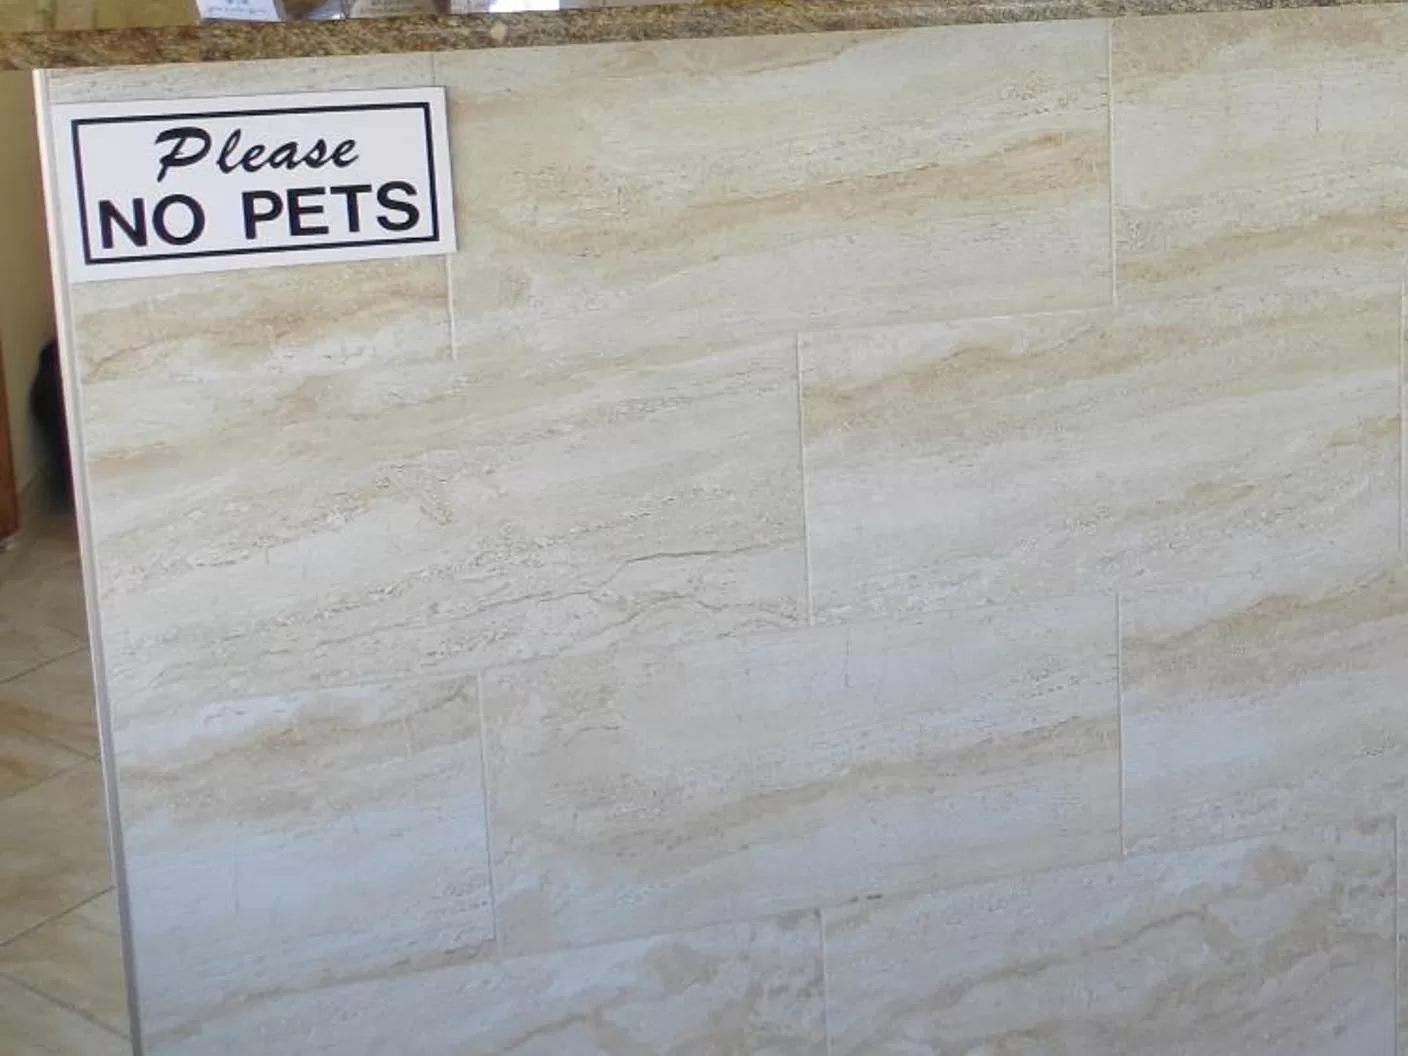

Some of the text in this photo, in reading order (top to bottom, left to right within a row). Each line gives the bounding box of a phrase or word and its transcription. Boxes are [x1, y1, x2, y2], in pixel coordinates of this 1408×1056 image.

[155, 125, 362, 183] Please
[97, 180, 421, 250] NO PETS
